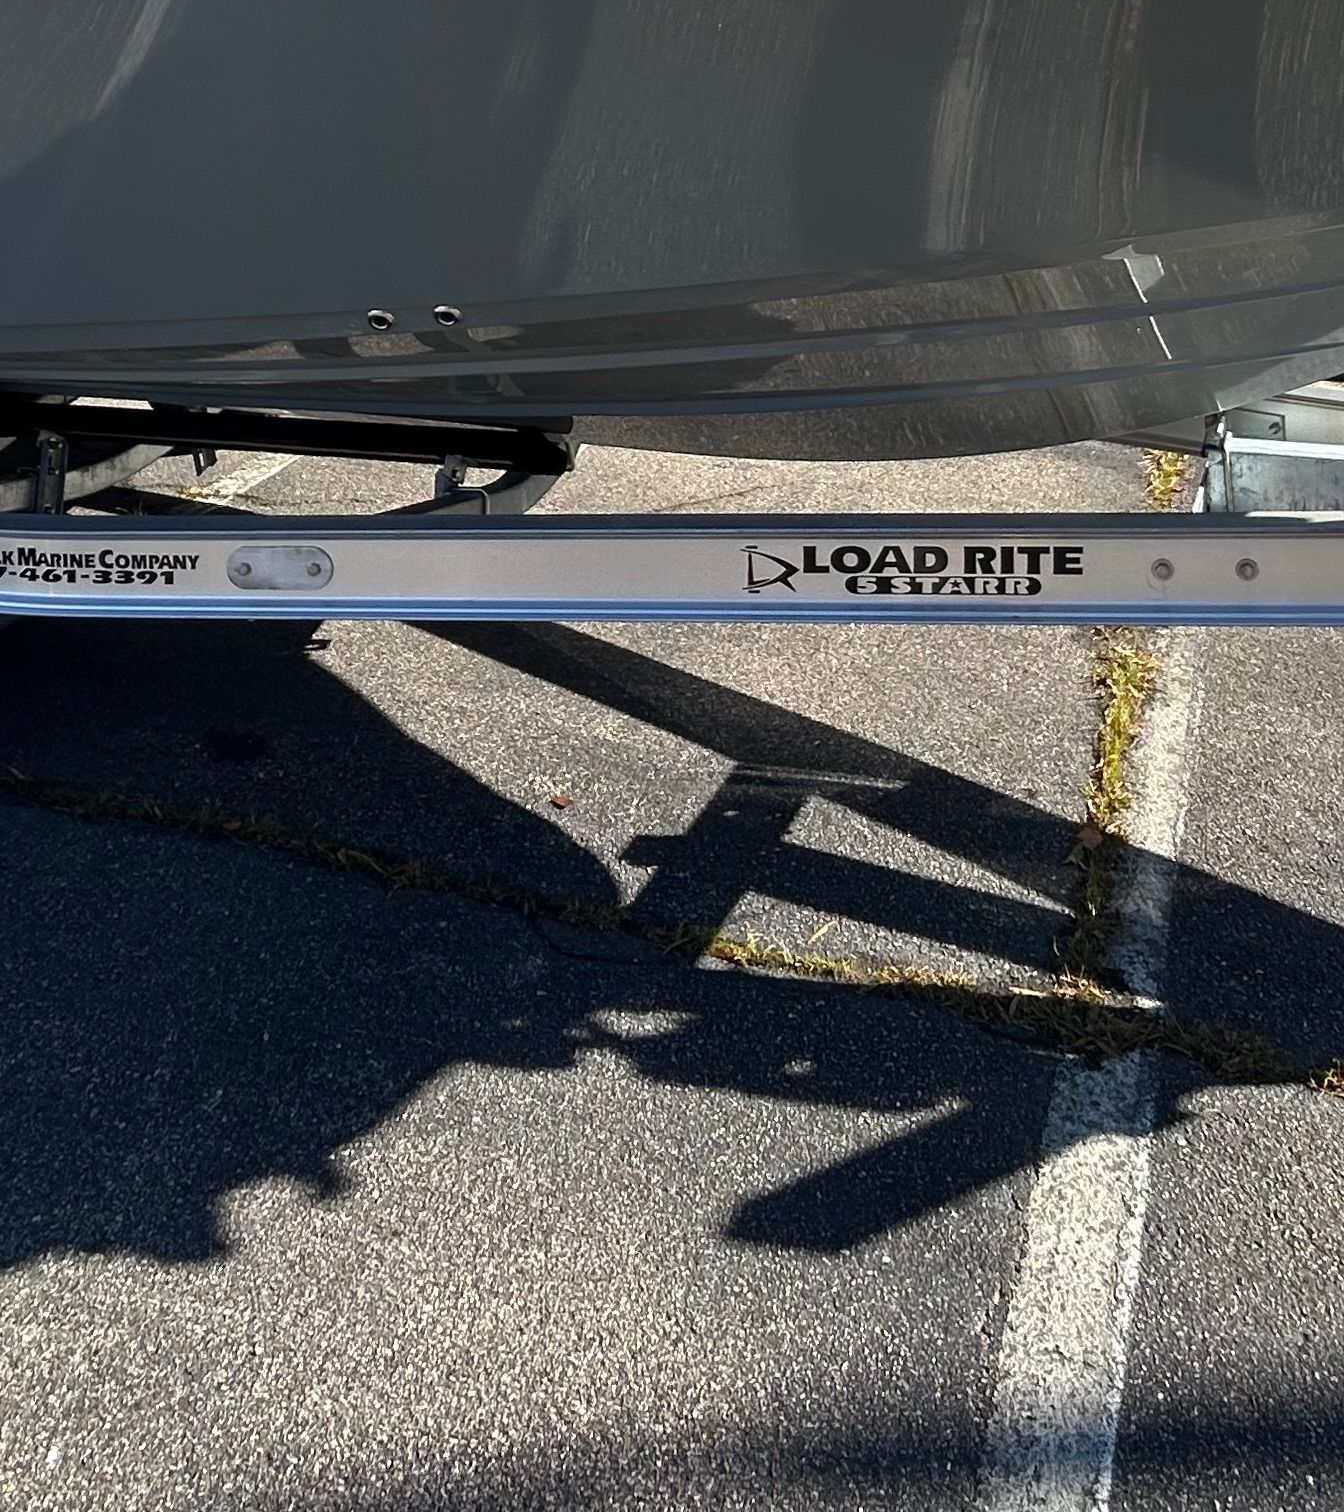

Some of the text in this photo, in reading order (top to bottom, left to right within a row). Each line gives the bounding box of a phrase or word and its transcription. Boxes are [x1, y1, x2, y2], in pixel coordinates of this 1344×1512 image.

[802, 545, 1084, 576] LOAD RITE
[856, 576, 1031, 595] 5 STARR
